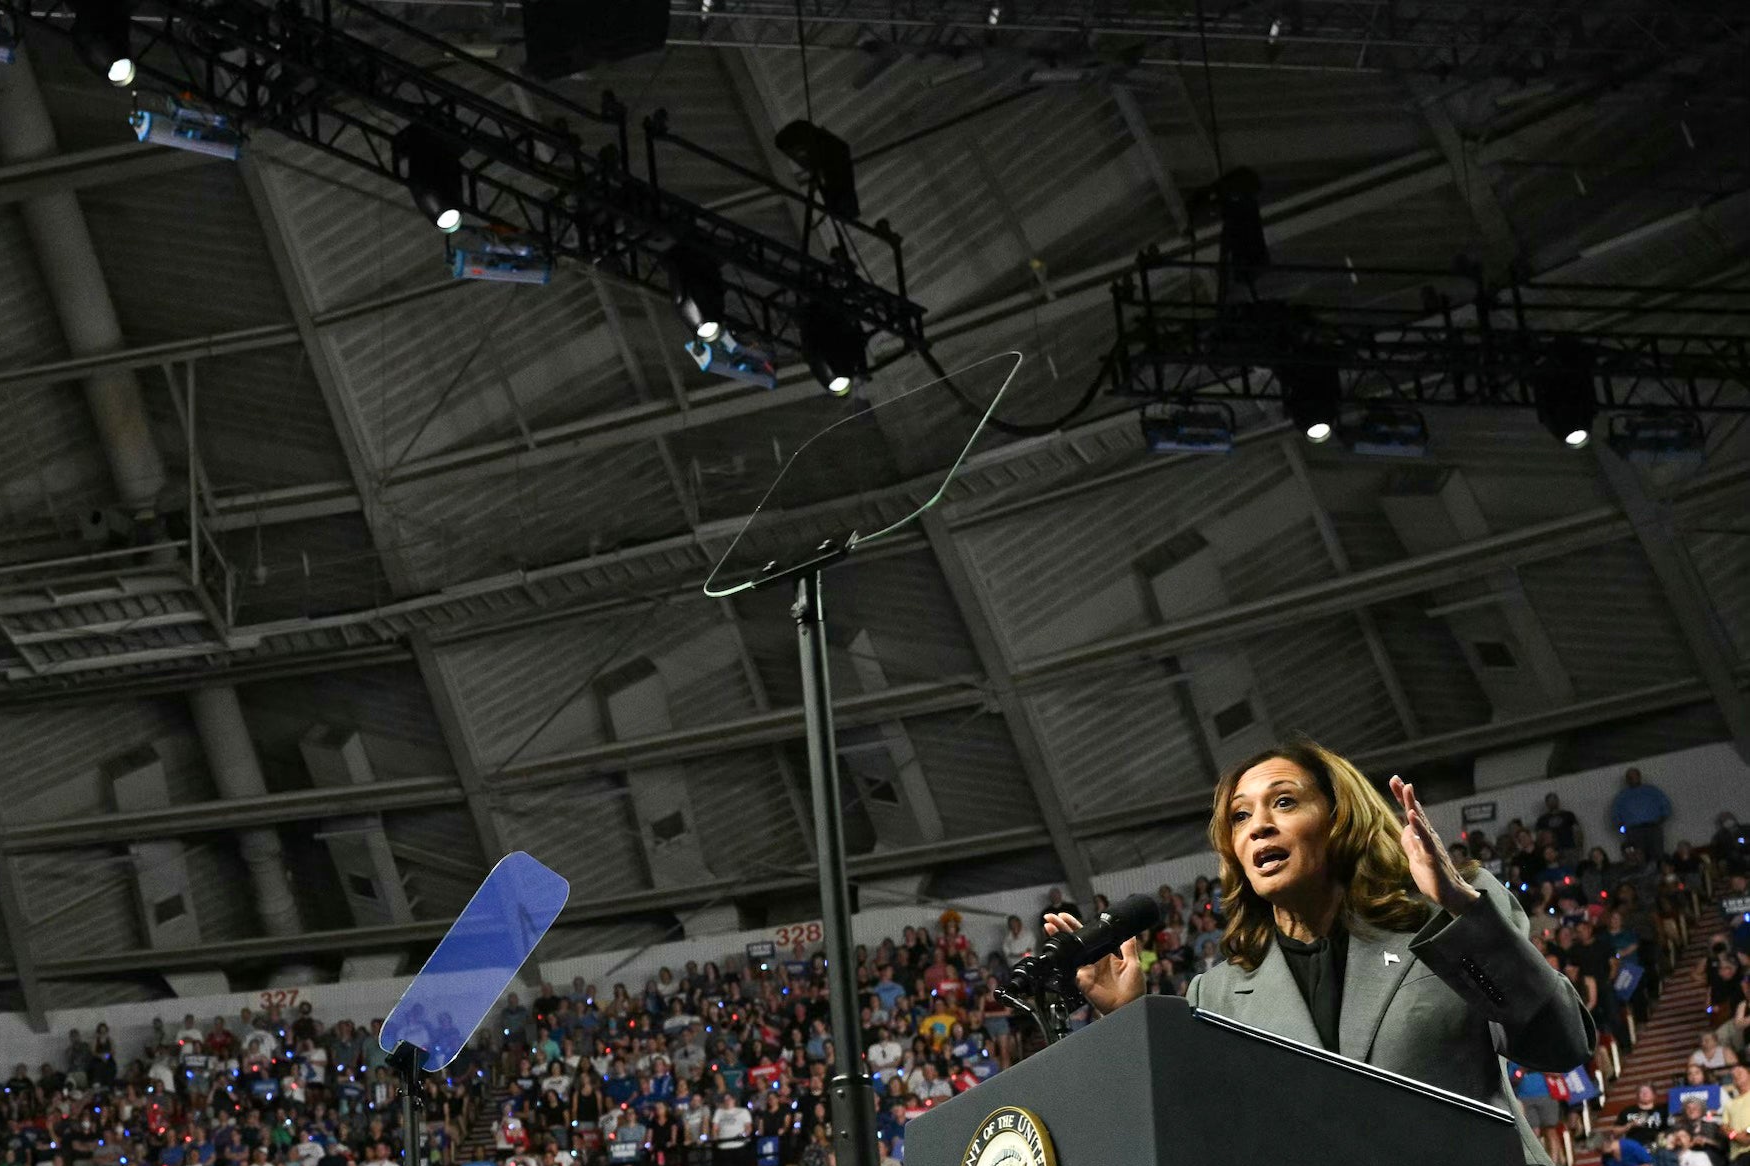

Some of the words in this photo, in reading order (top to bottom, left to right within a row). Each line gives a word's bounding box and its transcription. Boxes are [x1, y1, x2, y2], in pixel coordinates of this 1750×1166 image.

[776, 923, 821, 947] 328
[982, 1122, 996, 1141] OF
[997, 1114, 1014, 1130] THE
